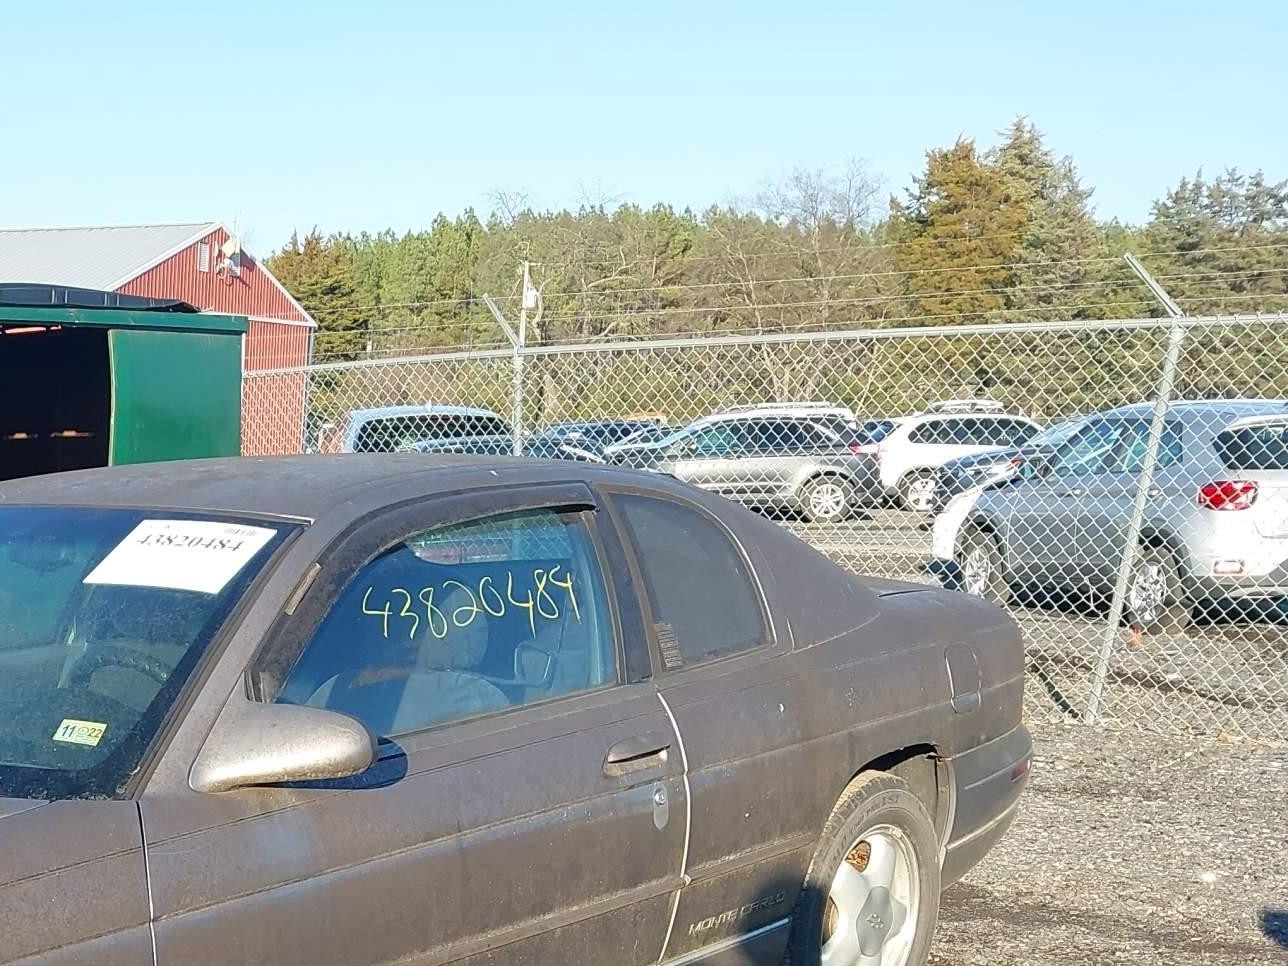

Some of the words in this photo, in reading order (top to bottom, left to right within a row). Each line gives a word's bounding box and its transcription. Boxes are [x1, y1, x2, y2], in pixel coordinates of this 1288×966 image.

[136, 533, 245, 551] 43820484
[362, 564, 582, 639] 43820484
[62, 724, 77, 737] 11
[87, 727, 103, 738] 22
[688, 907, 739, 936] MONTE
[739, 888, 786, 917] CARLO
